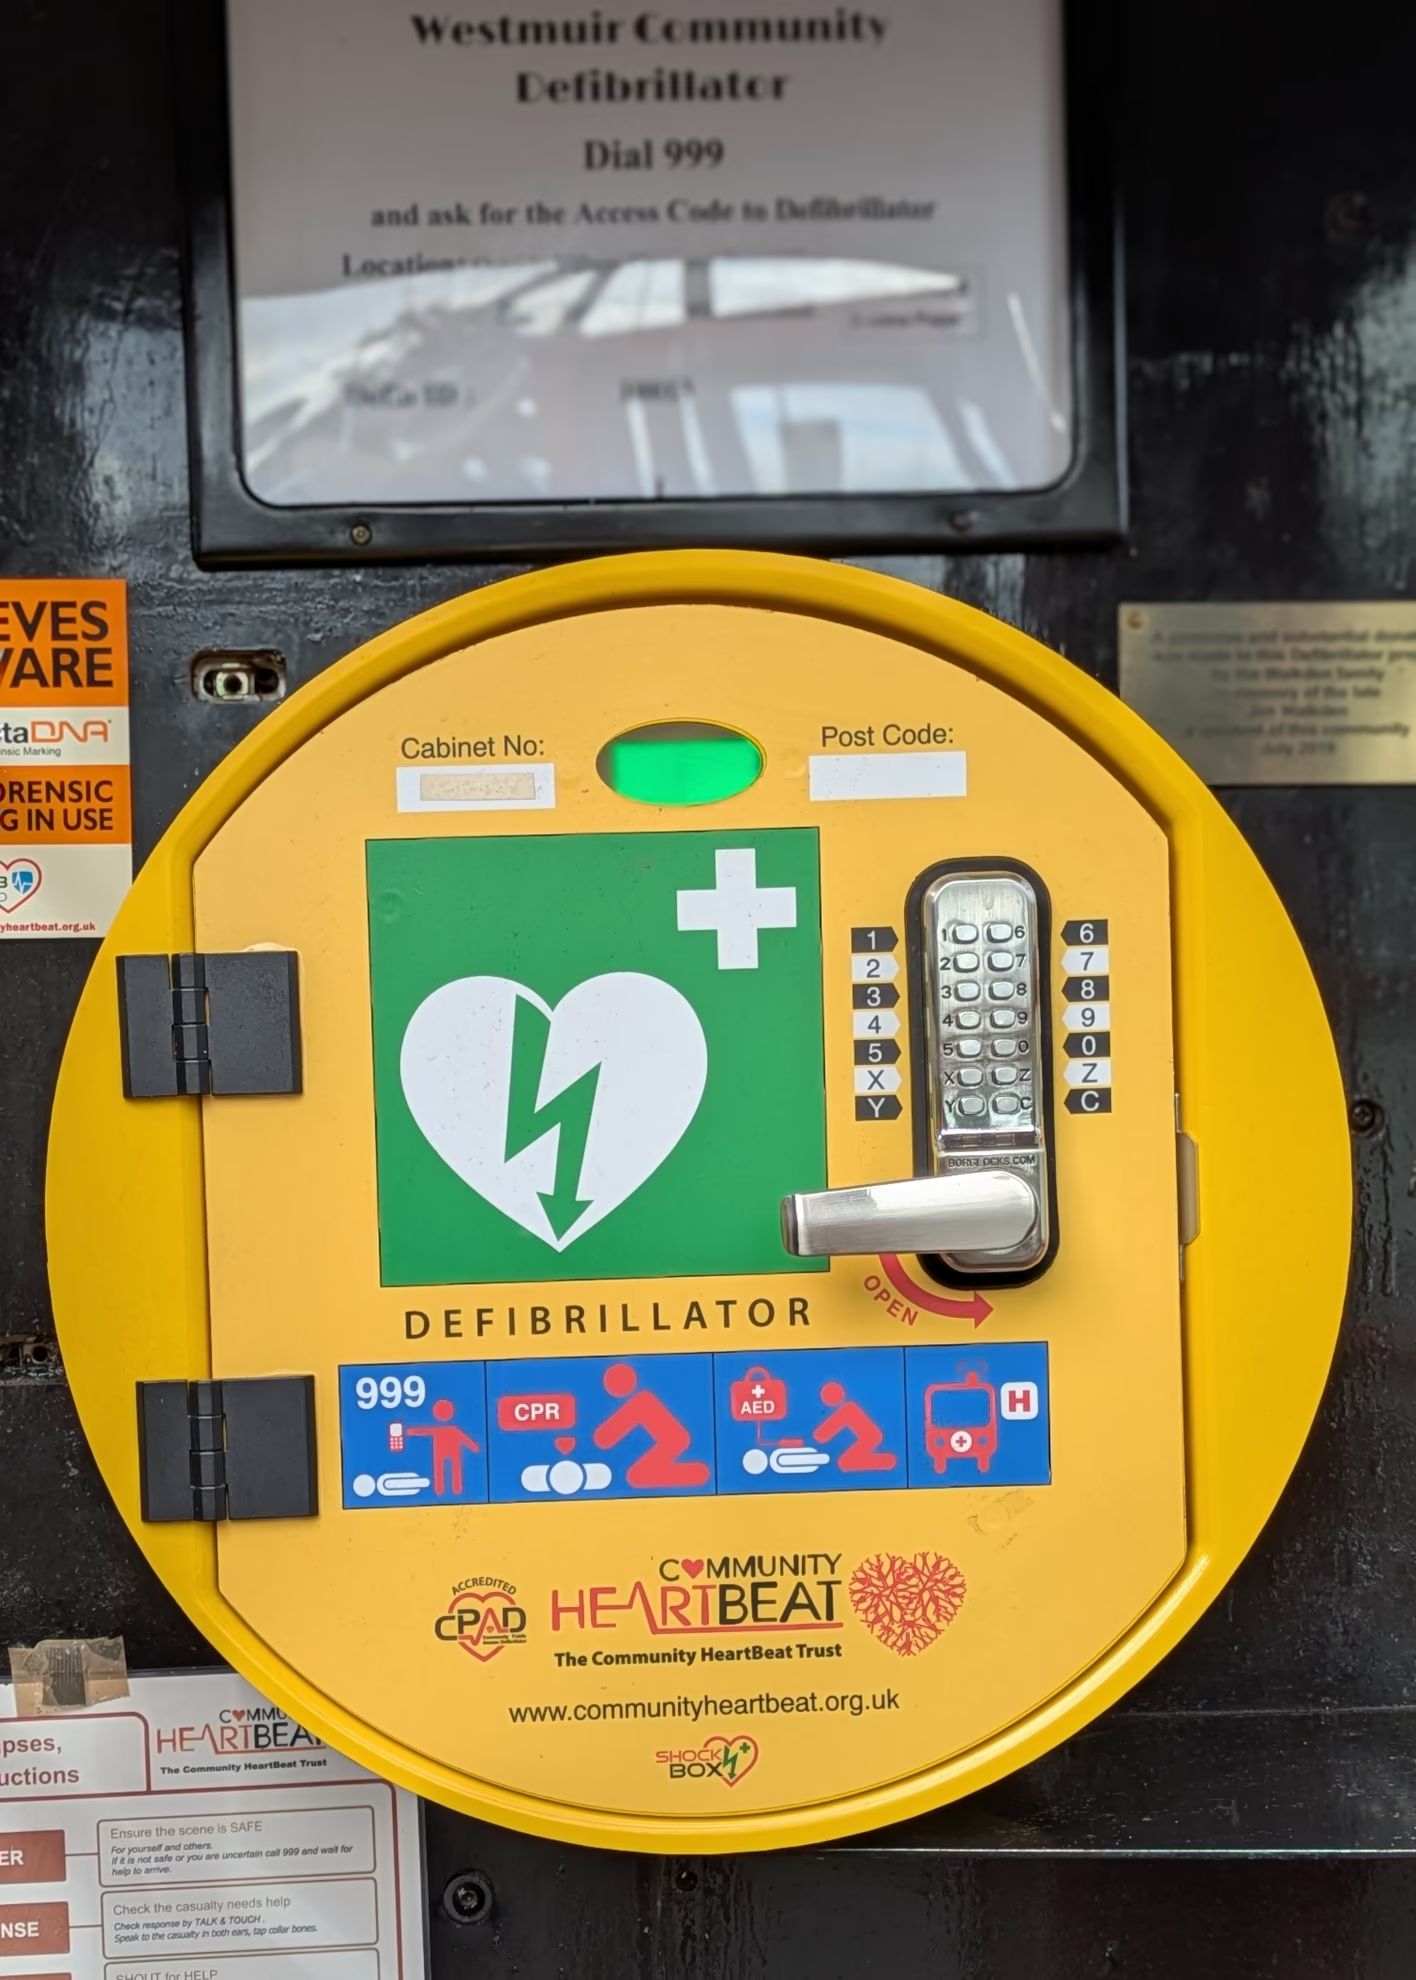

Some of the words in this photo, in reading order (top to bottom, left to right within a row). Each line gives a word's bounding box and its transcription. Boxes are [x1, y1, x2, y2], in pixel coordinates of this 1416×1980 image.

[411, 11, 624, 46] Westmuir
[633, 9, 890, 47] Community
[515, 69, 789, 105] Defibrillator
[583, 138, 654, 171] Dial
[663, 138, 725, 170] 999
[371, 203, 418, 227] and
[427, 203, 472, 226] ask
[480, 203, 516, 225] for
[525, 202, 566, 225] the
[574, 201, 660, 225] Access
[667, 198, 736, 222] Code
[820, 726, 878, 748] Post
[882, 725, 955, 747] Code:
[23, 746, 61, 758] Marking
[401, 736, 497, 760] Cabinet
[502, 735, 546, 757] No:
[0, 780, 113, 803] RENSIC
[27, 808, 54, 831] IN
[63, 808, 113, 831] USE
[867, 930, 877, 949] 1
[941, 928, 947, 943] 1
[1014, 925, 1025, 939] 6
[1079, 923, 1095, 943] 6
[865, 958, 881, 978] 2
[940, 957, 951, 972] 2
[1015, 954, 1026, 968] 7
[1080, 951, 1095, 971] 7
[866, 986, 882, 1007] 3
[940, 986, 952, 1000] 3
[1016, 982, 1027, 996] 8
[1080, 979, 1095, 999] 8
[867, 1015, 882, 1035] 4
[942, 1014, 954, 1028] 4
[1017, 1011, 1028, 1025] 9
[1080, 1008, 1096, 1028] 9
[868, 1043, 883, 1063] 5
[942, 1043, 954, 1057] 5
[1018, 1040, 1029, 1053] 0
[1081, 1036, 1097, 1056] 0
[867, 1070, 886, 1090] X
[944, 1071, 955, 1086] X
[1019, 1068, 1031, 1082] Z
[1081, 1062, 1098, 1083] Z
[867, 1097, 886, 1118] Y
[945, 1099, 956, 1114] Y
[1019, 1096, 1032, 1111] C
[1080, 1091, 1100, 1112] C
[948, 1155, 1036, 1168] BORGLOCKS.COM
[863, 1275, 919, 1327] OPEN
[405, 1297, 811, 1340] DEFIBRILLATOR
[356, 1375, 426, 1410] 999
[1008, 1389, 1032, 1413] H
[513, 1402, 561, 1421] CPR
[740, 1400, 776, 1416] AED
[451, 1576, 517, 1597] ACCREDITED
[551, 1580, 843, 1633] HEARTBEAT
[434, 1606, 527, 1643] CPAD
[554, 1651, 588, 1668] The
[591, 1648, 696, 1667] Community
[700, 1645, 792, 1663] HeartBeat
[796, 1643, 842, 1659] Trust
[509, 1688, 900, 1724] www.communityheartbeat.org.uk
[0, 1738, 62, 1759] pses,
[655, 1748, 722, 1764] SHOCK
[160, 1766, 180, 1775] The
[183, 1763, 241, 1775] Community
[244, 1760, 297, 1770] HeartBeat
[300, 1758, 328, 1768] Trust
[669, 1761, 725, 1779] BOX
[110, 1827, 152, 1840] Ensure
[156, 1826, 176, 1837] the
[179, 1825, 214, 1836] scene
[217, 1823, 227, 1834] is
[230, 1821, 263, 1833] SAFE
[111, 1846, 126, 1855] For
[128, 1844, 163, 1855] yourself
[165, 1842, 182, 1851] and
[183, 1842, 213, 1851] others.
[127, 1855, 135, 1864] is
[137, 1855, 152, 1863] not
[154, 1854, 174, 1863] safe
[175, 1854, 185, 1862] or
[186, 1853, 203, 1863] you
[205, 1853, 220, 1861] are
[222, 1849, 263, 1860] uncertain
[265, 1848, 281, 1858] call
[282, 1847, 300, 1857] 999
[301, 1845, 319, 1855] and
[320, 1845, 339, 1854] wait
[340, 1844, 354, 1854] for
[112, 1867, 131, 1877] help
[133, 1866, 142, 1875] to
[113, 1903, 151, 1916] Check
[154, 1903, 172, 1913] the
[175, 1899, 224, 1912] casualty
[227, 1897, 262, 1909] needs
[265, 1896, 291, 1909] help
[0, 1921, 40, 1938] NSE
[113, 1922, 140, 1931] Check
[142, 1920, 180, 1931] response
[182, 1919, 193, 1929] by
[194, 1917, 218, 1927] TALK
[219, 1916, 227, 1926] &
[229, 1915, 261, 1925] TOUCH
[114, 1933, 140, 1945] Speak
[141, 1933, 151, 1942] to
[151, 1932, 166, 1941] the
[167, 1930, 200, 1940] casualty
[201, 1929, 210, 1938] in
[211, 1928, 230, 1938] both
[253, 1927, 267, 1937] tap
[268, 1925, 291, 1935] collar
[184, 1968, 218, 1980] HELP
